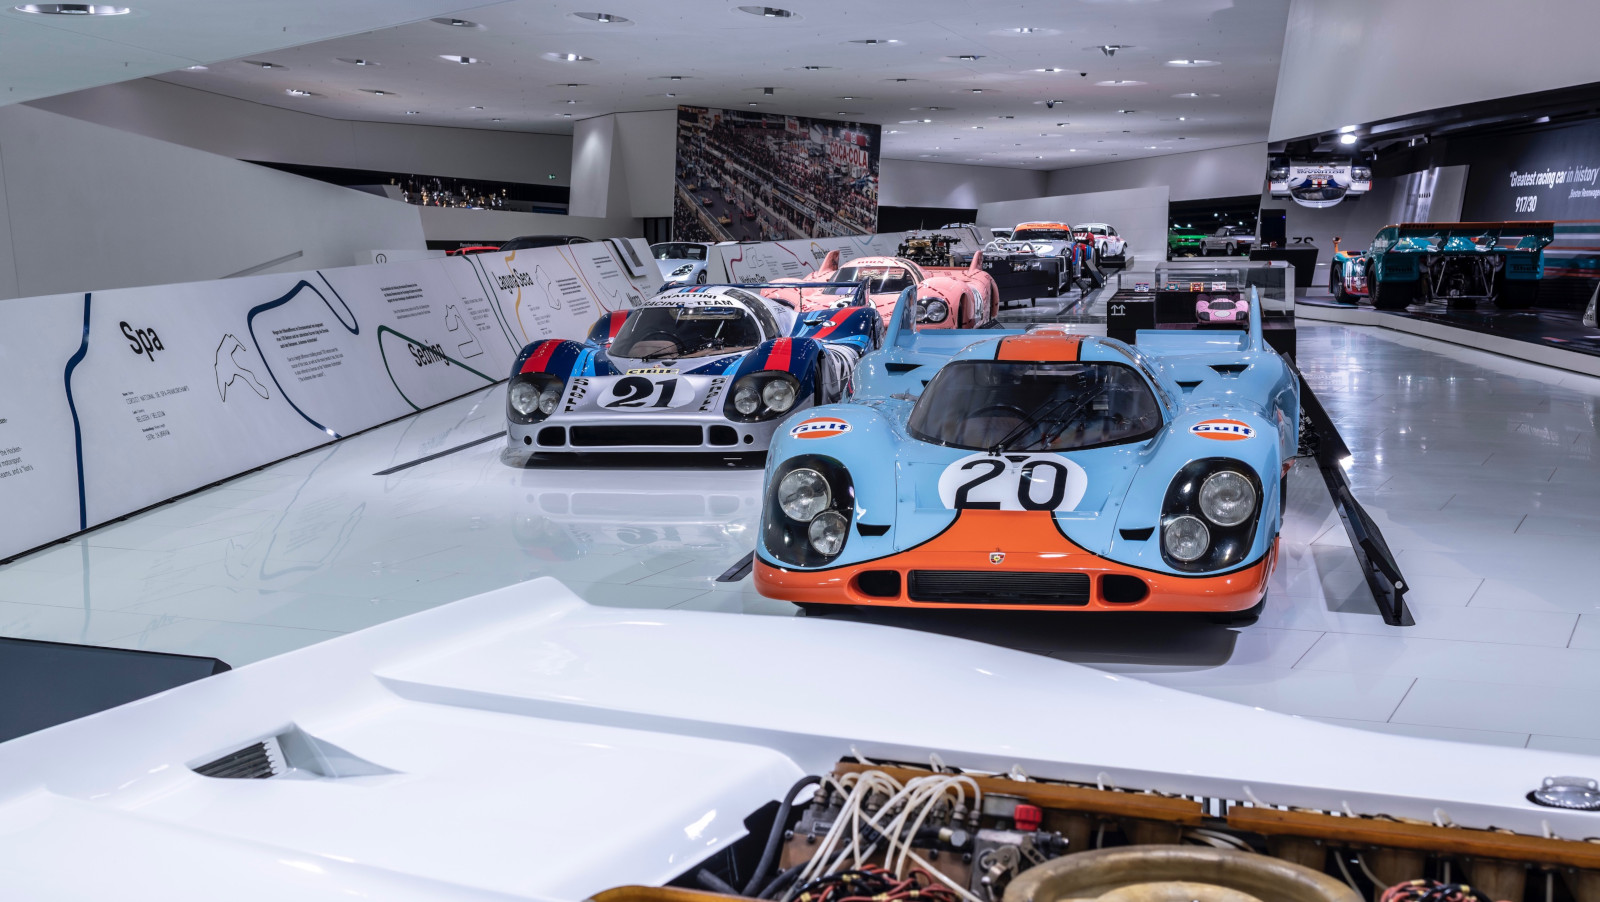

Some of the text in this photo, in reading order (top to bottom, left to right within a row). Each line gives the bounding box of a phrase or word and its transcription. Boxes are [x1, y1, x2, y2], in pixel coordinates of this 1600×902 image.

[830, 142, 868, 168] COCA-COLA
[1535, 168, 1556, 189] racing
[1555, 171, 1567, 184] car
[1566, 167, 1574, 183] in
[1515, 195, 1537, 212] 917/30
[120, 321, 165, 362] Spa
[407, 340, 450, 367] Sebring
[605, 376, 678, 408] 21
[792, 423, 849, 433] Gulf
[1192, 424, 1252, 435] Gulf
[954, 459, 1068, 511] 20
